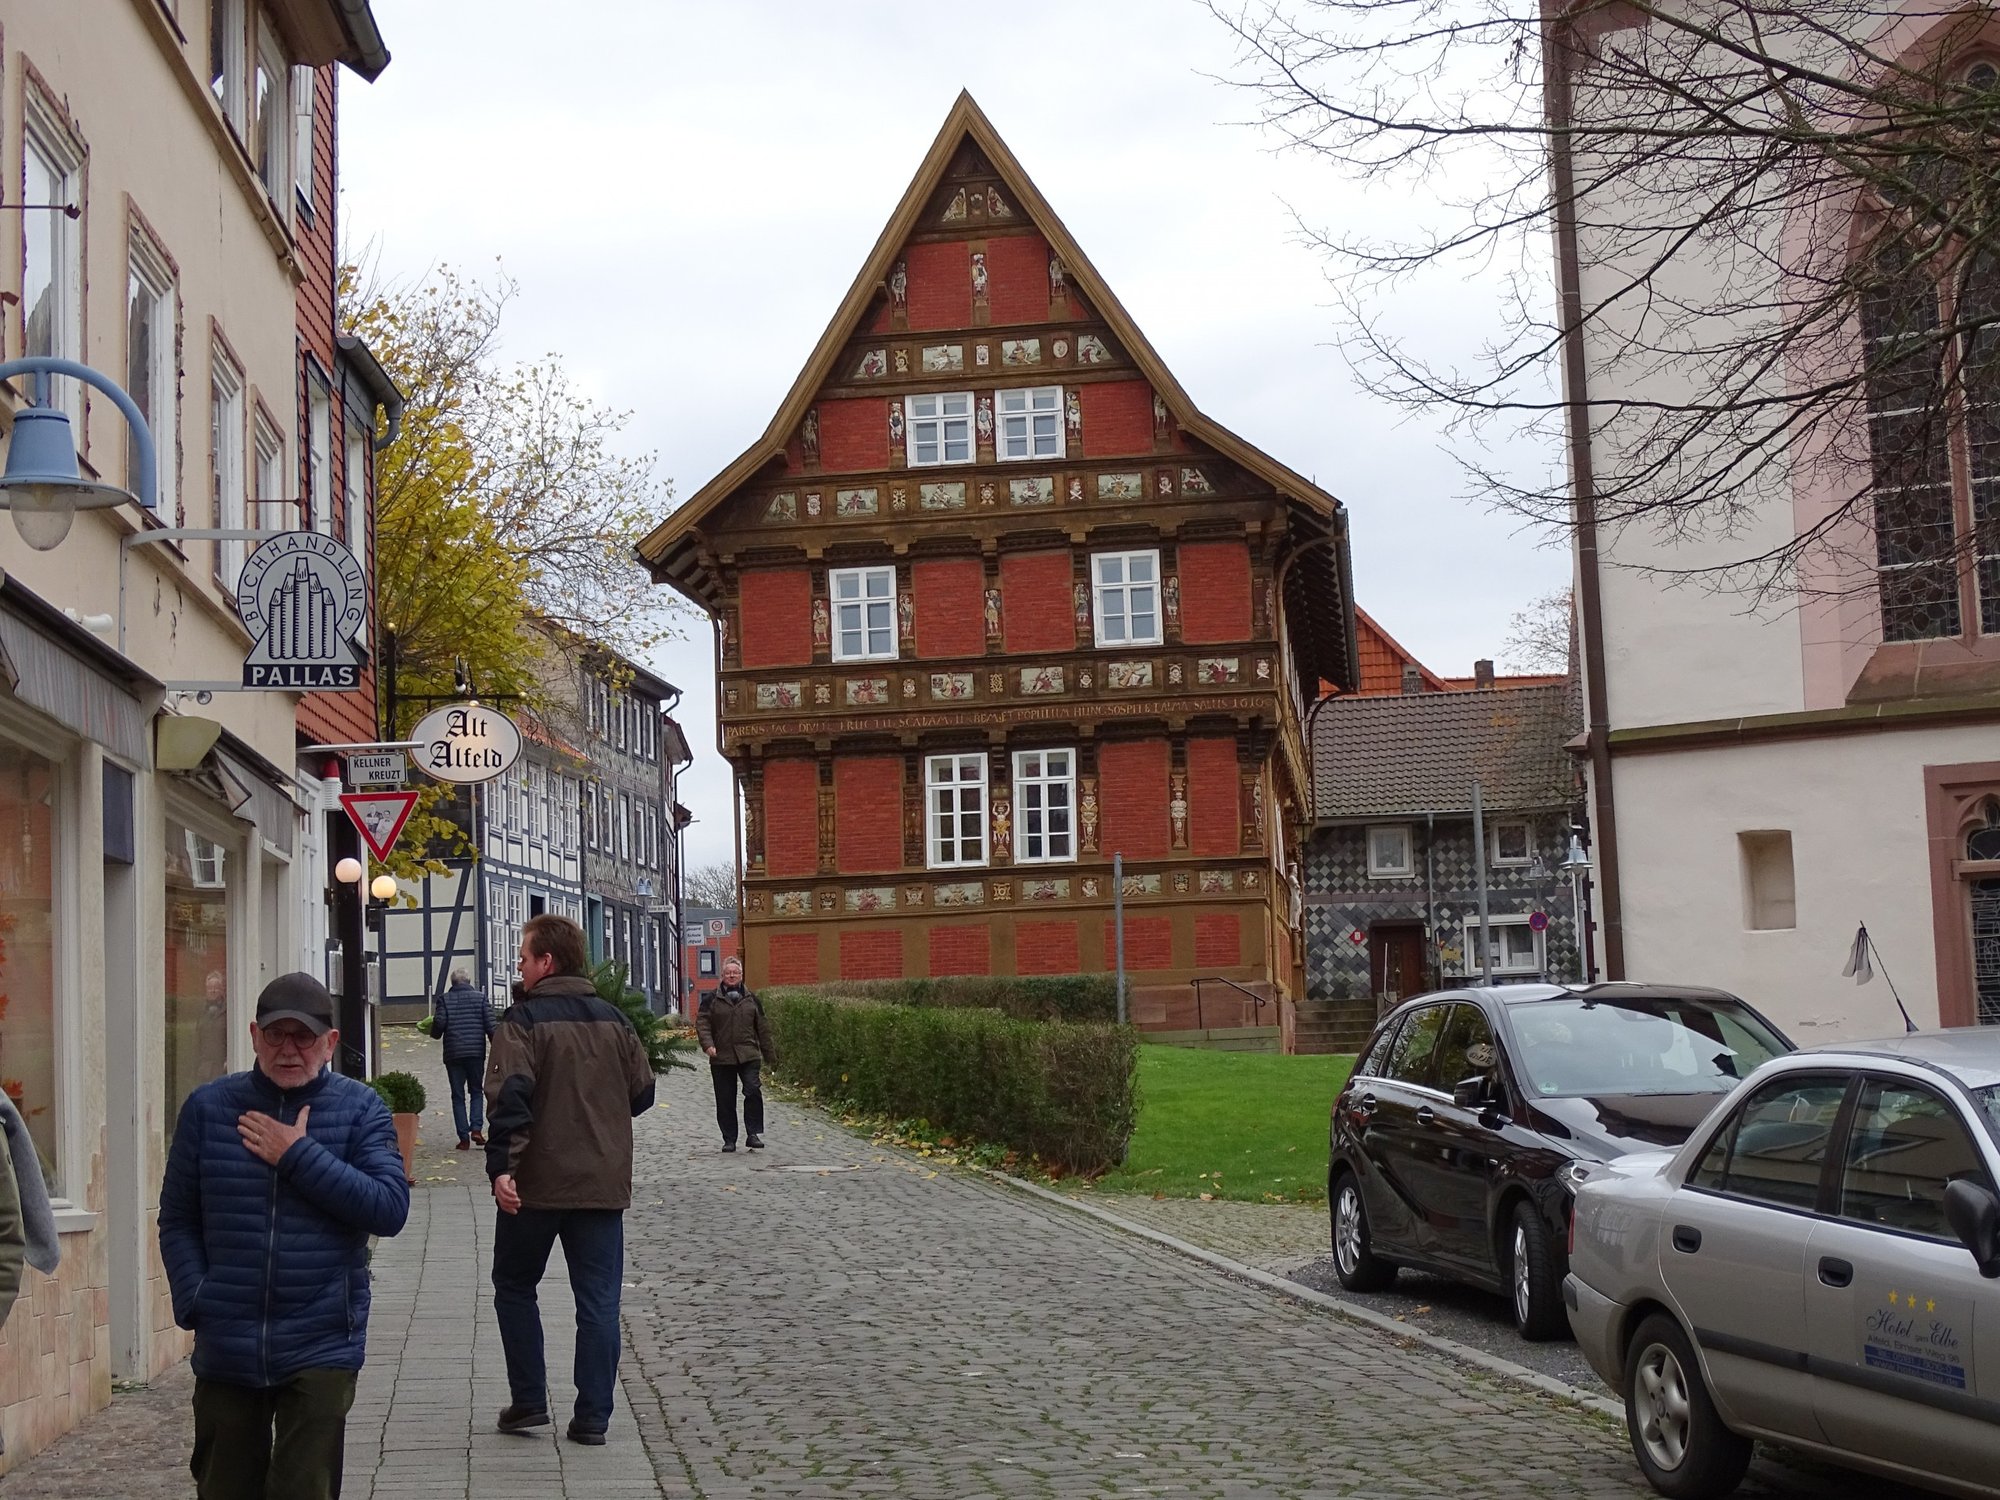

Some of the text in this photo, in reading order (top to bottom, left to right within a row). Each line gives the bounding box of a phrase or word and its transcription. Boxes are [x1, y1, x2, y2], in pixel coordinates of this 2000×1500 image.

[240, 535, 363, 622] BUCHHANDLUNG
[251, 666, 354, 686] PALLAS
[445, 709, 488, 738] Alt
[353, 757, 391, 768] KELLNER
[429, 740, 503, 769] Alfeld
[368, 769, 401, 780] KREUZT
[1866, 1308, 1915, 1337] Hotel
[1929, 1320, 1959, 1349] Elbe
